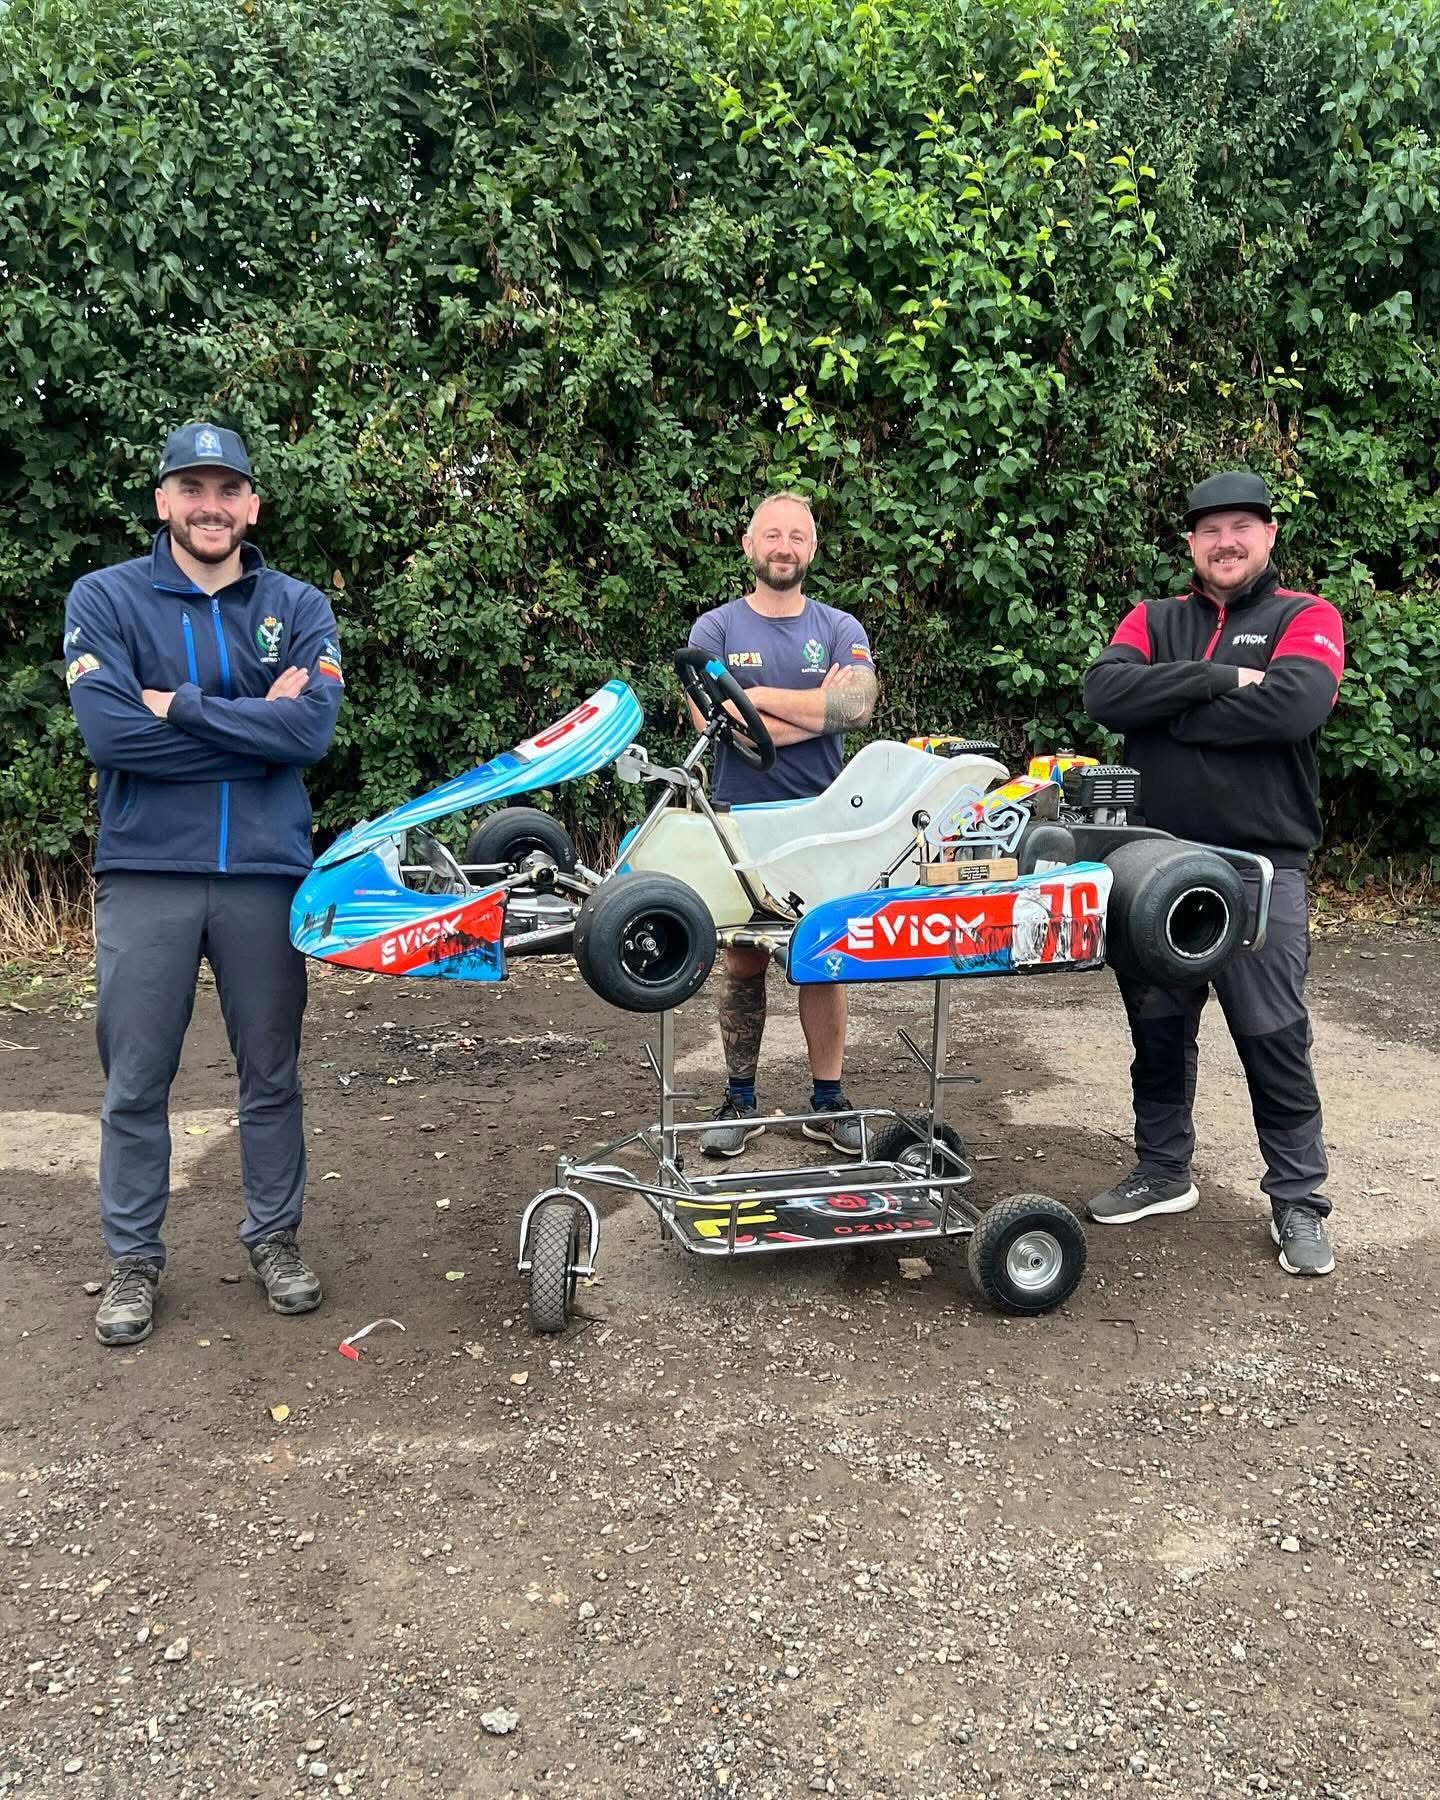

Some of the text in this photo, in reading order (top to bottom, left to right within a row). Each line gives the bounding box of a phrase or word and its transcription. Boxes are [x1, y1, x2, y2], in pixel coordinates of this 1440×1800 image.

[1232, 634, 1268, 645] EVIOK
[728, 652, 763, 667] RPM
[381, 912, 464, 967] EVIOK
[847, 911, 986, 949] EVIOK
[1040, 881, 1101, 963] 76
